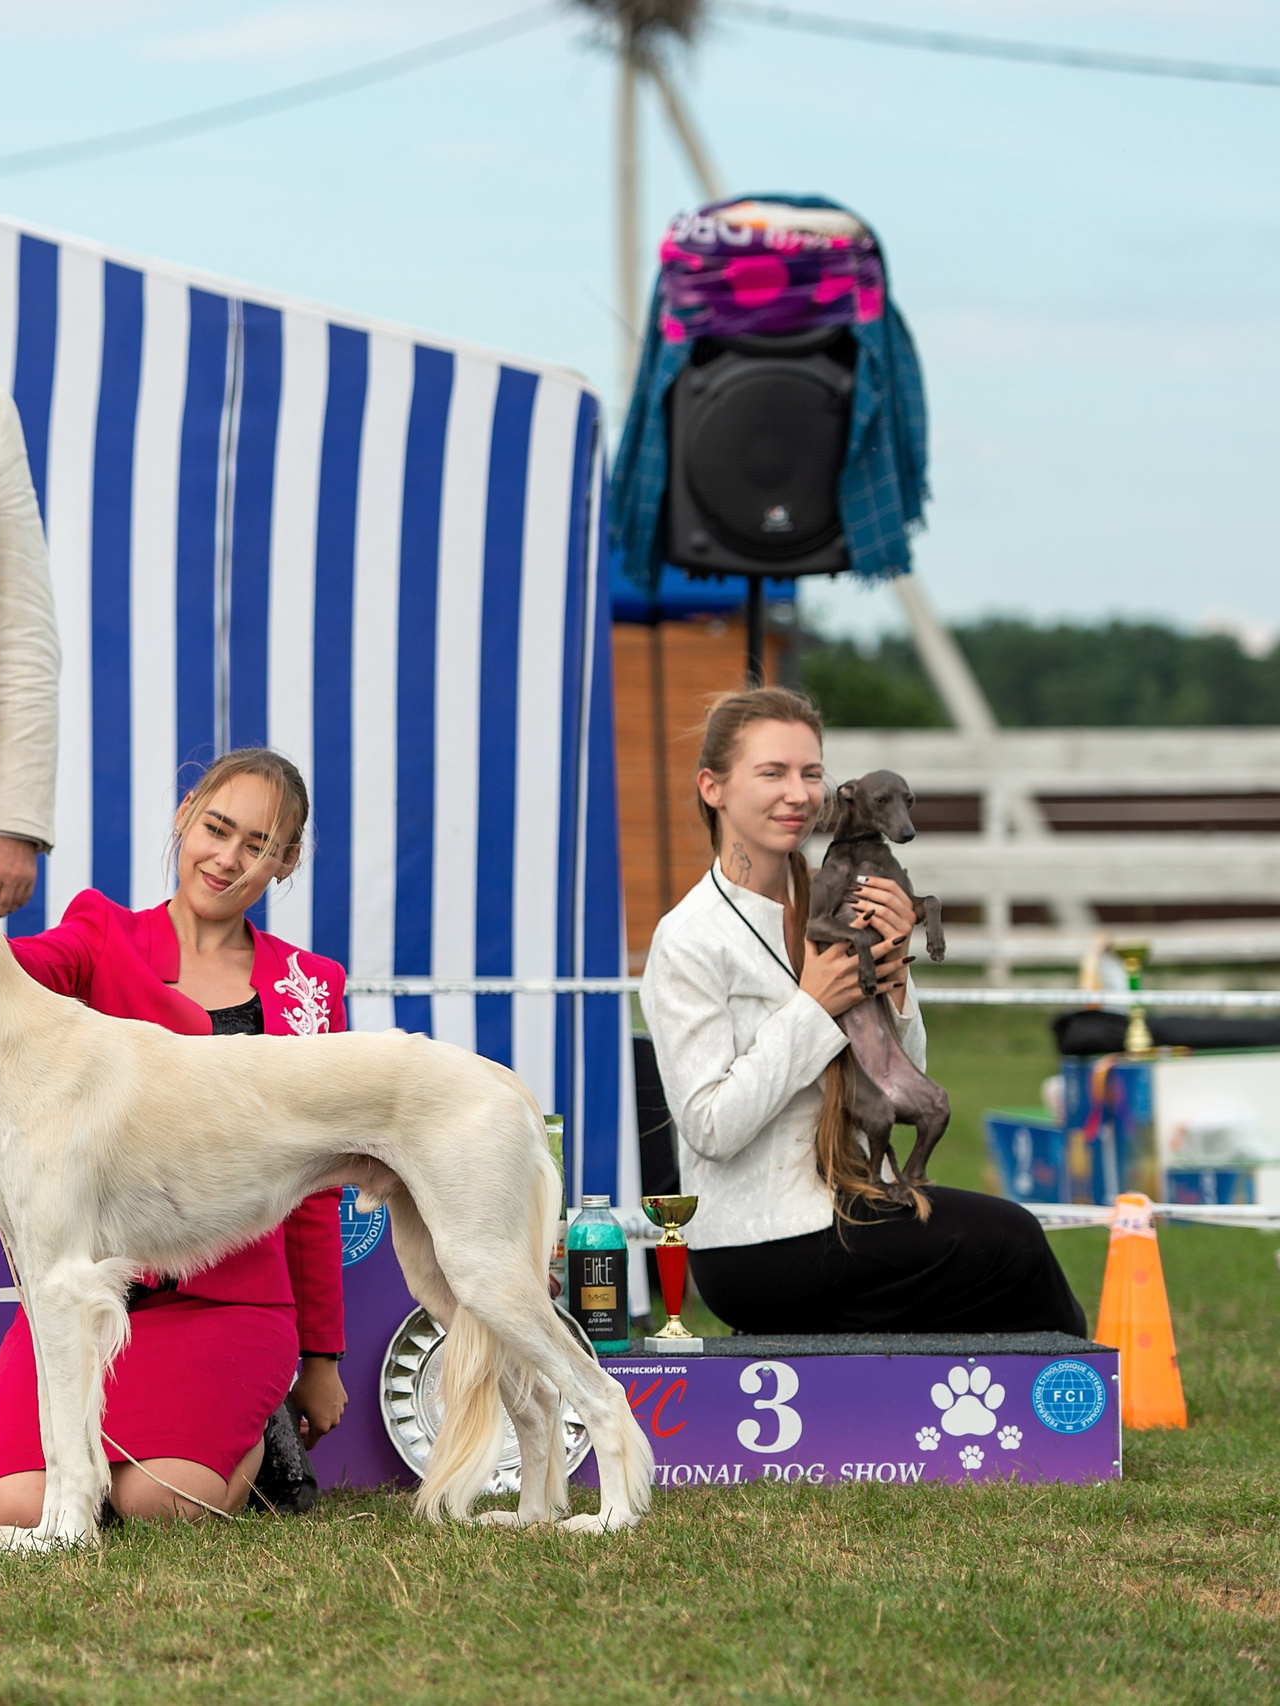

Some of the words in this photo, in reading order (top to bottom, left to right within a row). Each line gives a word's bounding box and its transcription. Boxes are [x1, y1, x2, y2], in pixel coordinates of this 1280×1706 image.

[602, 1364, 662, 1375] ЛОГИЧЕСКИЙ
[664, 1366, 688, 1374] КЛУБ
[1038, 1363, 1088, 1385] CYNOLOGIQUE
[1080, 1370, 1104, 1428] INTERNATIONALE
[626, 1377, 688, 1439] КС
[737, 1360, 803, 1453] 3
[651, 1464, 748, 1486] TIONAL
[762, 1463, 825, 1485] DOG
[839, 1462, 926, 1485] SHOW
